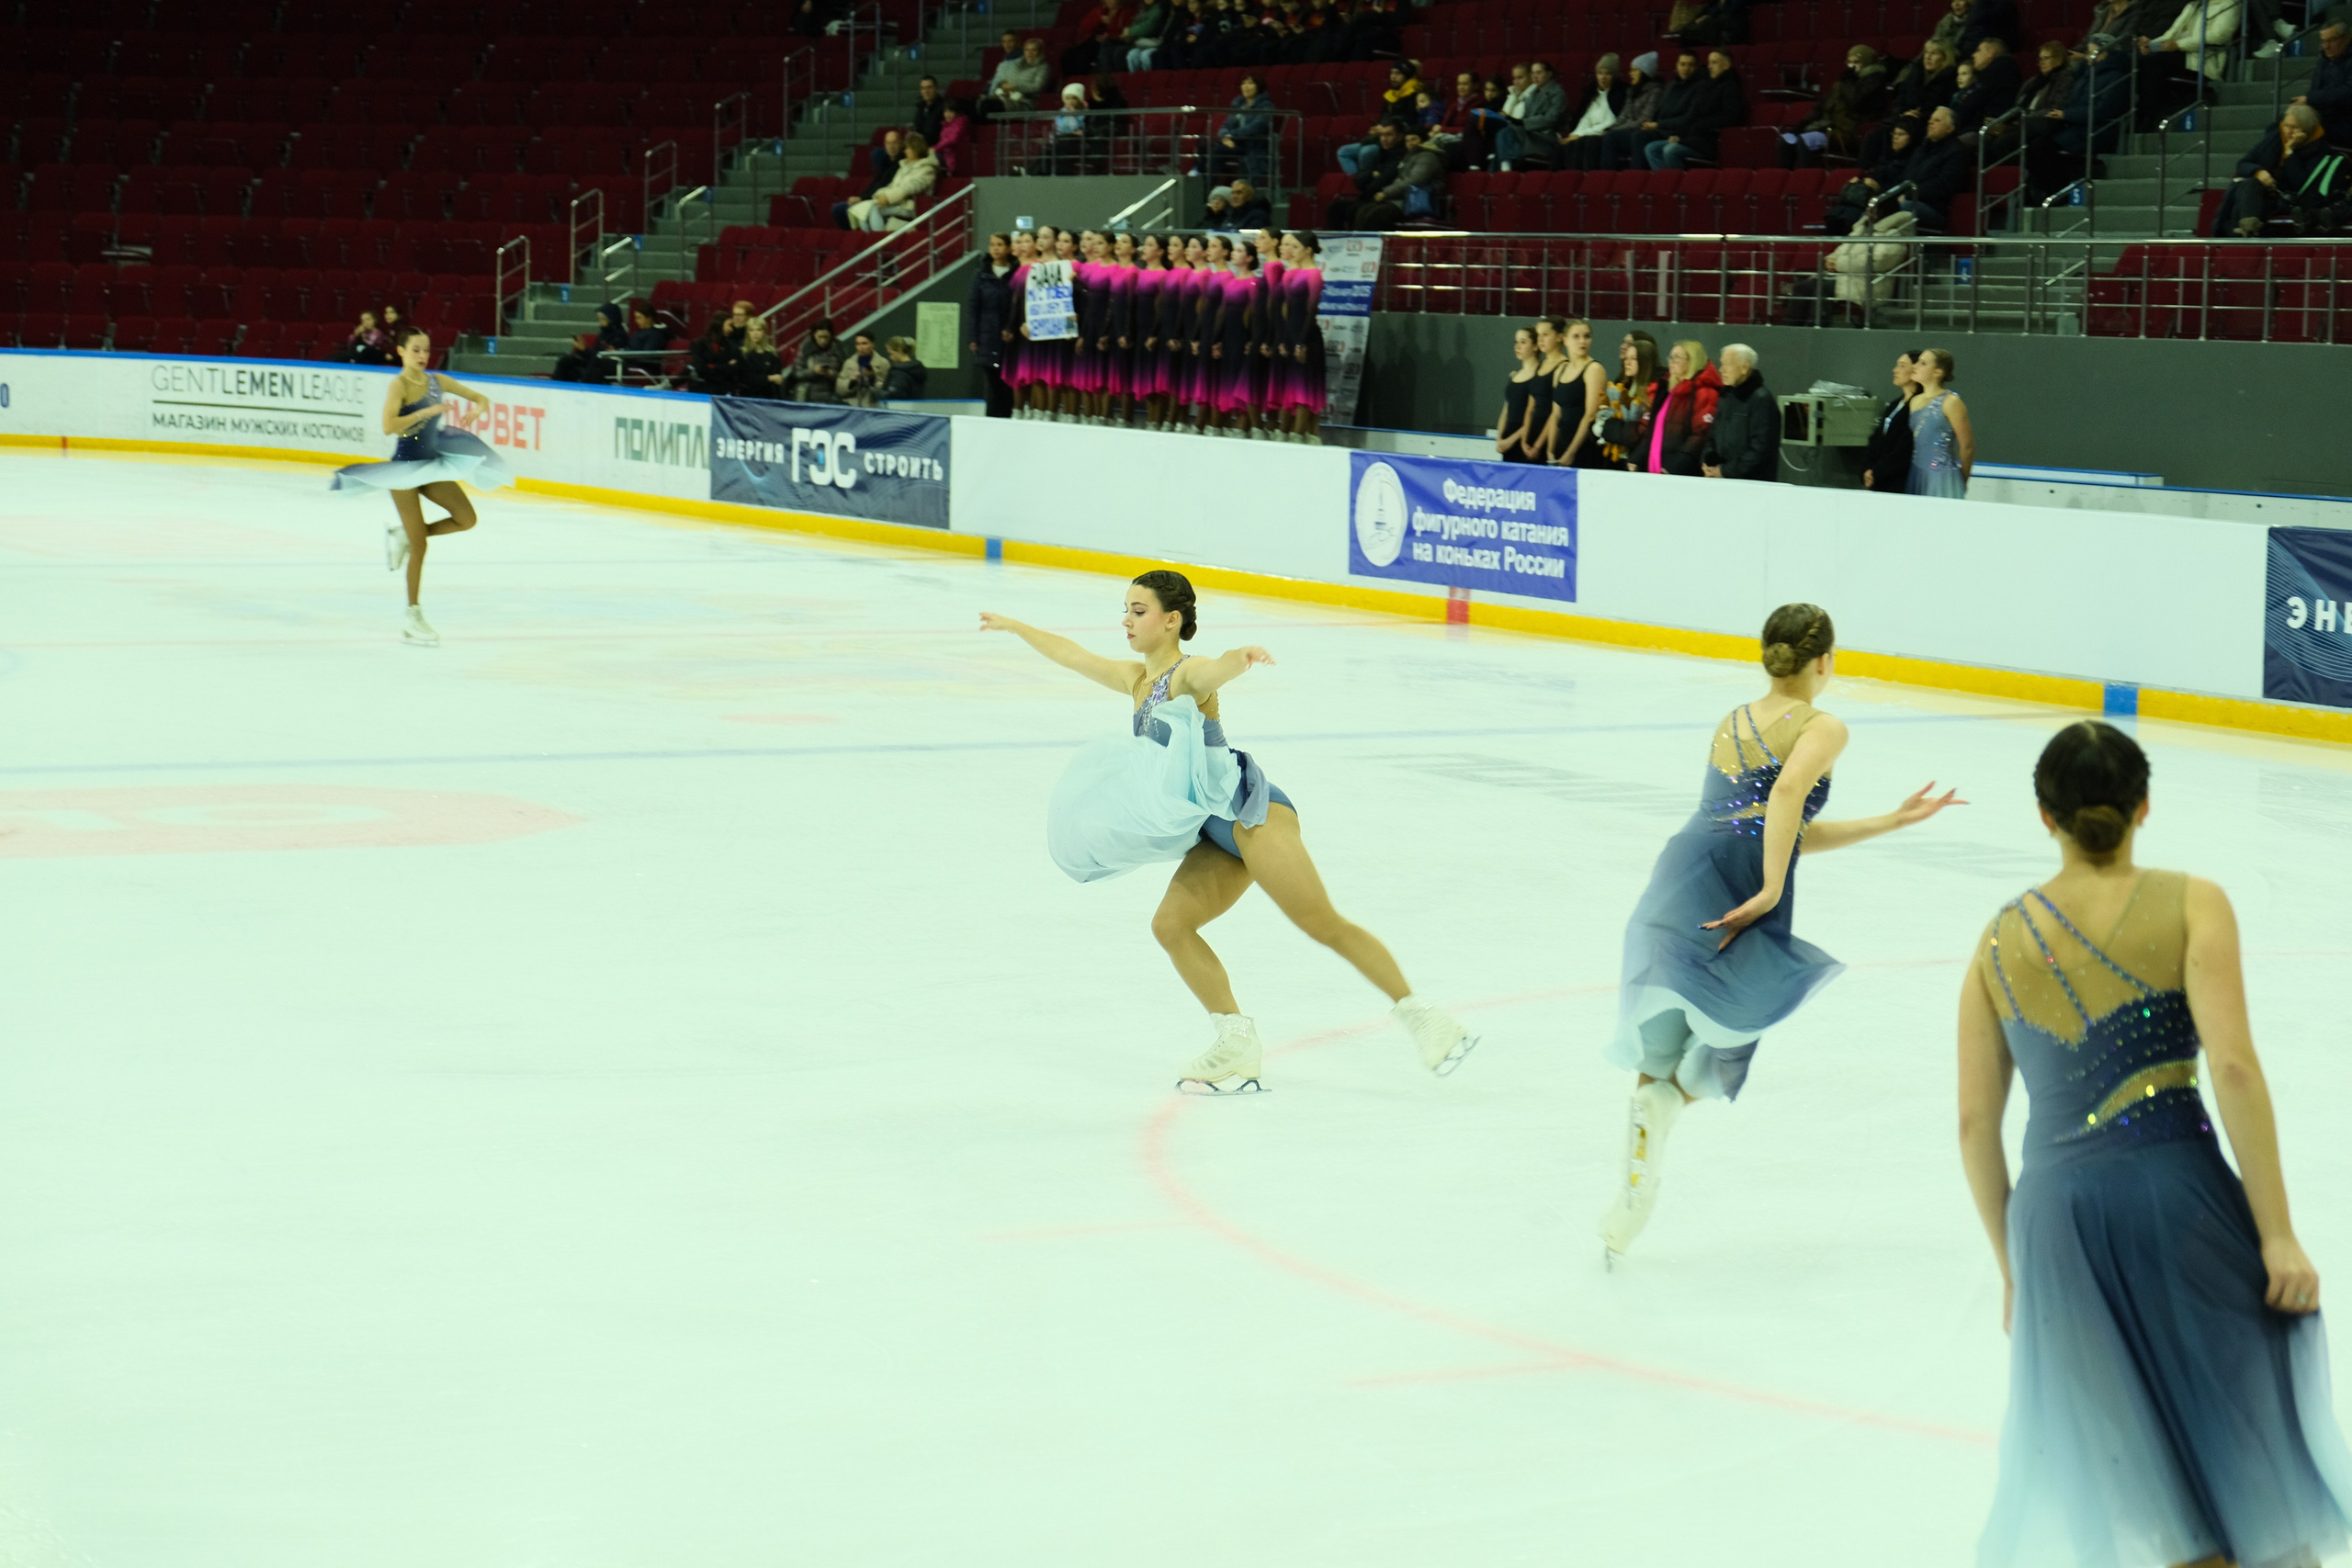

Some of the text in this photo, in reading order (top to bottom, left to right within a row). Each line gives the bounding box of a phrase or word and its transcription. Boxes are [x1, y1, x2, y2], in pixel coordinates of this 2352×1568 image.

[151, 365, 365, 404] GENTLEMEN LEAGUE
[153, 412, 365, 442] МАГАЗИН МУЖСКИХ КОСТЮМОВ
[615, 416, 710, 469] ПОЛИПЛ
[716, 427, 944, 489] ЭНЕРГИЯ ГЭС СТРОИТЬ
[1443, 479, 1535, 512] Федерация
[1412, 506, 1568, 546] фигурного катания
[1412, 541, 1565, 578] на коньках России
